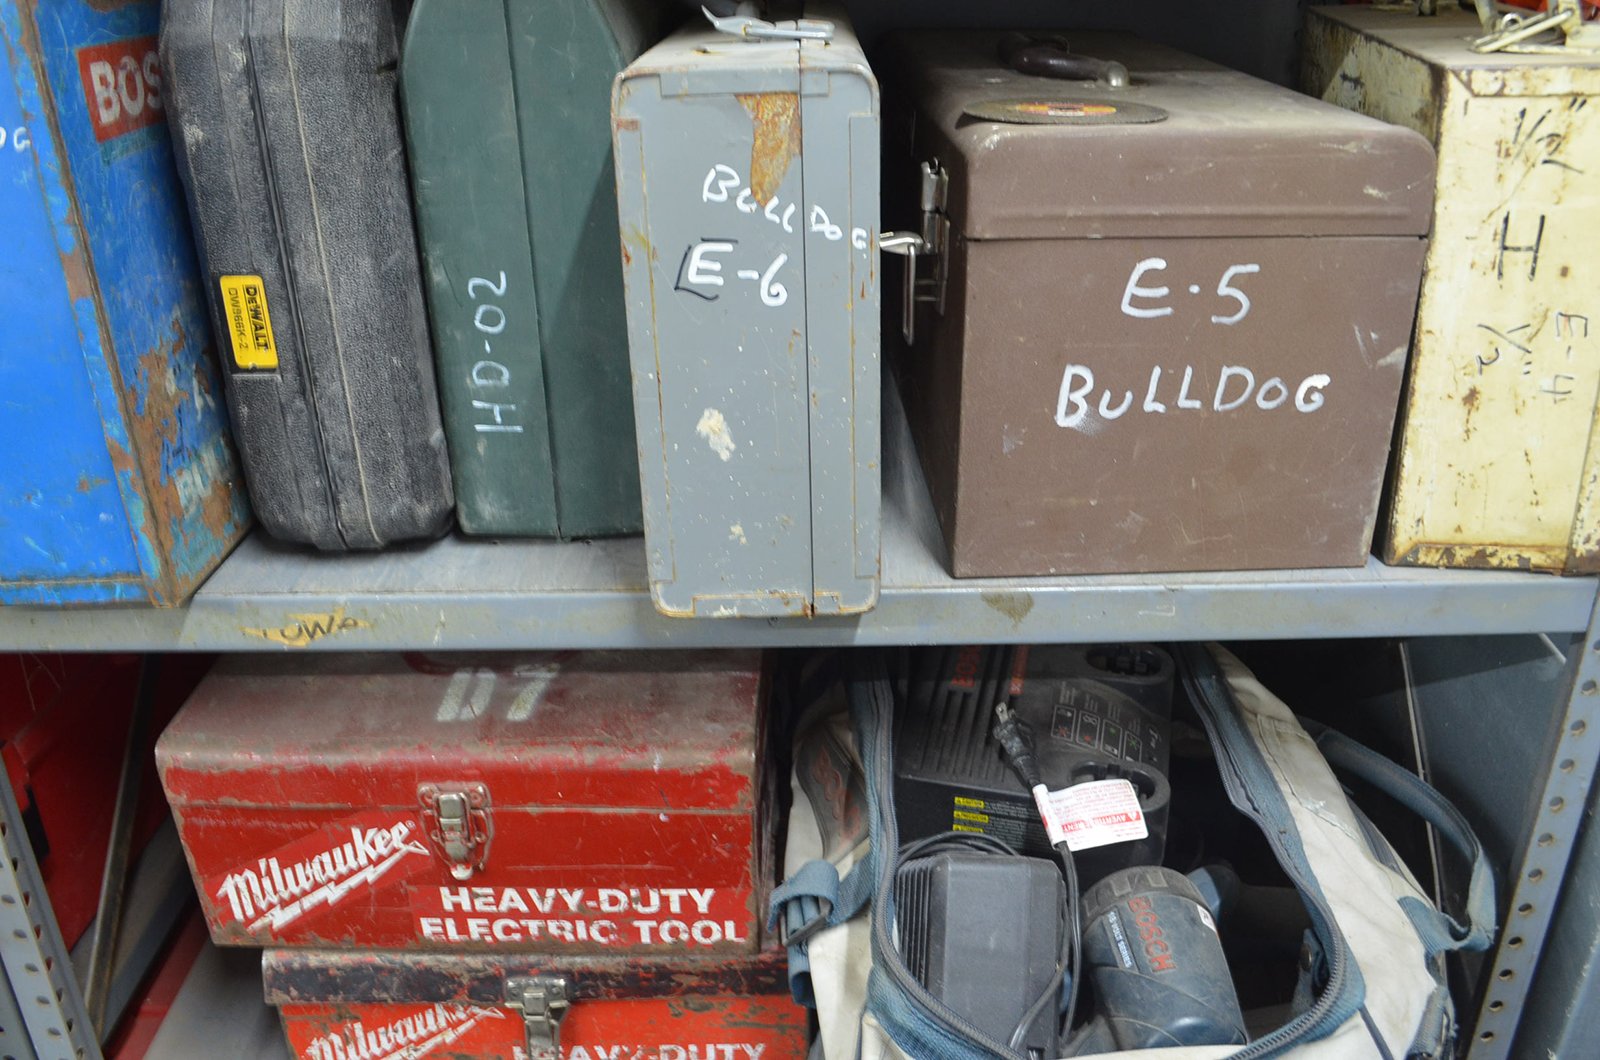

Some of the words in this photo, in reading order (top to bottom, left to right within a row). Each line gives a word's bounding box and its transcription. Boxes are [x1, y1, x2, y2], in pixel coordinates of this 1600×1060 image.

[674, 237, 788, 307] E-6
[1497, 211, 1545, 282] H
[468, 270, 524, 433] HD-02
[216, 820, 411, 922] Milwaukee
[438, 886, 715, 915] HEAVY-DUTY
[418, 917, 617, 943] ELECTRIC
[632, 919, 747, 945] TOOL
[1128, 896, 1177, 972] BOSCH
[304, 1003, 483, 1060] Milwauk
[512, 1043, 766, 1060] HAVY-DUTY
